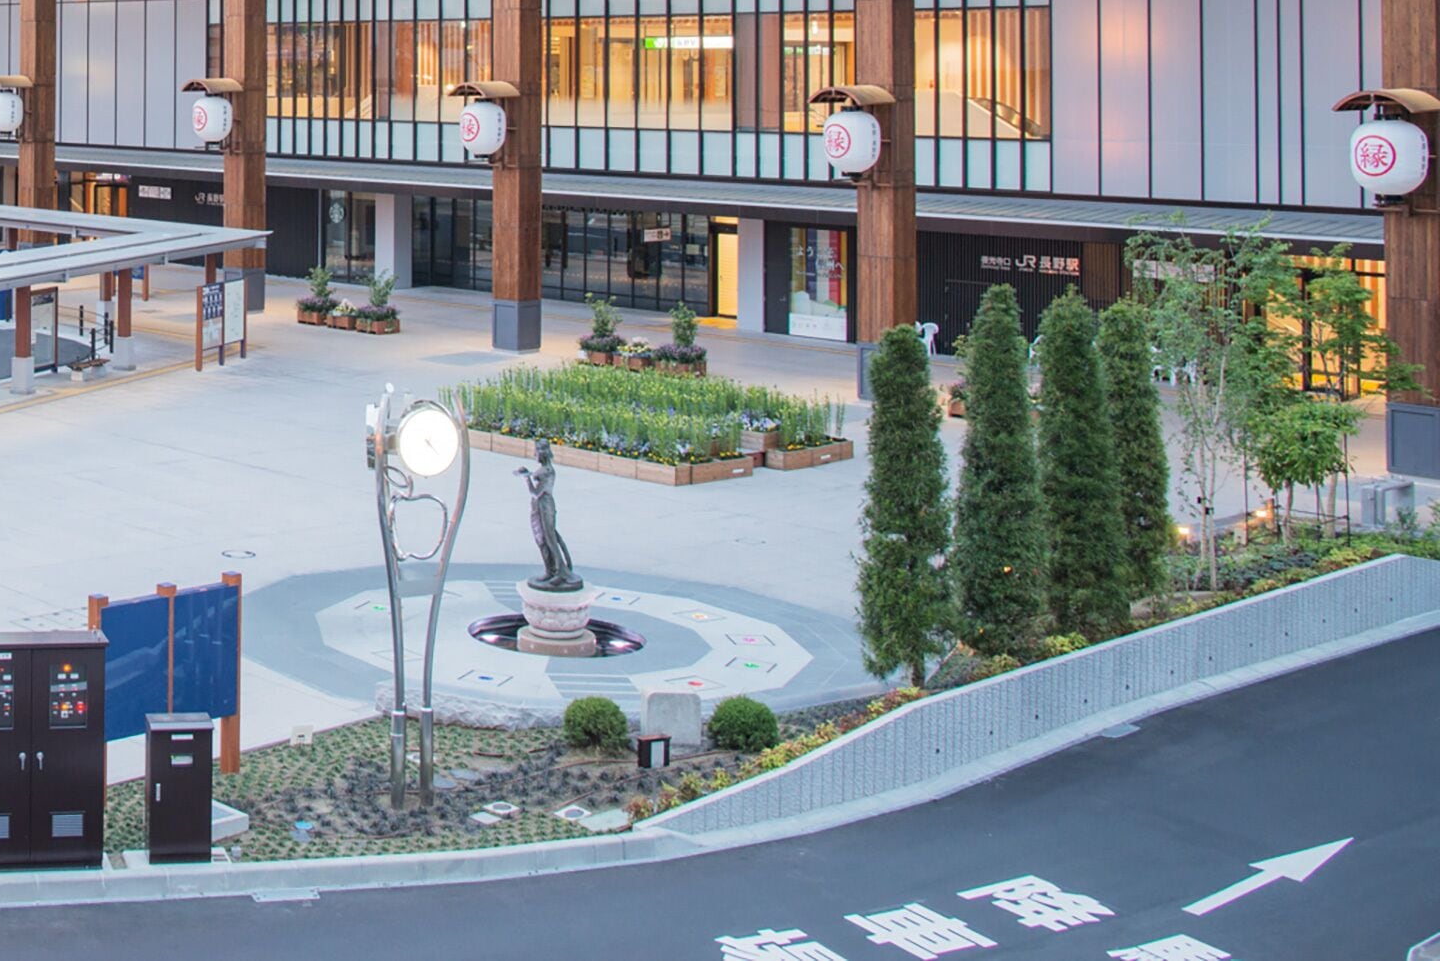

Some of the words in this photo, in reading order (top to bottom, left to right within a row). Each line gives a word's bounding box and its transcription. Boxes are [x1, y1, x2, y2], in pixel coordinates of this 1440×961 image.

[1360, 143, 1388, 168] 縁
[1016, 255, 1036, 269] JR
[1039, 256, 1080, 271] 長野駅
